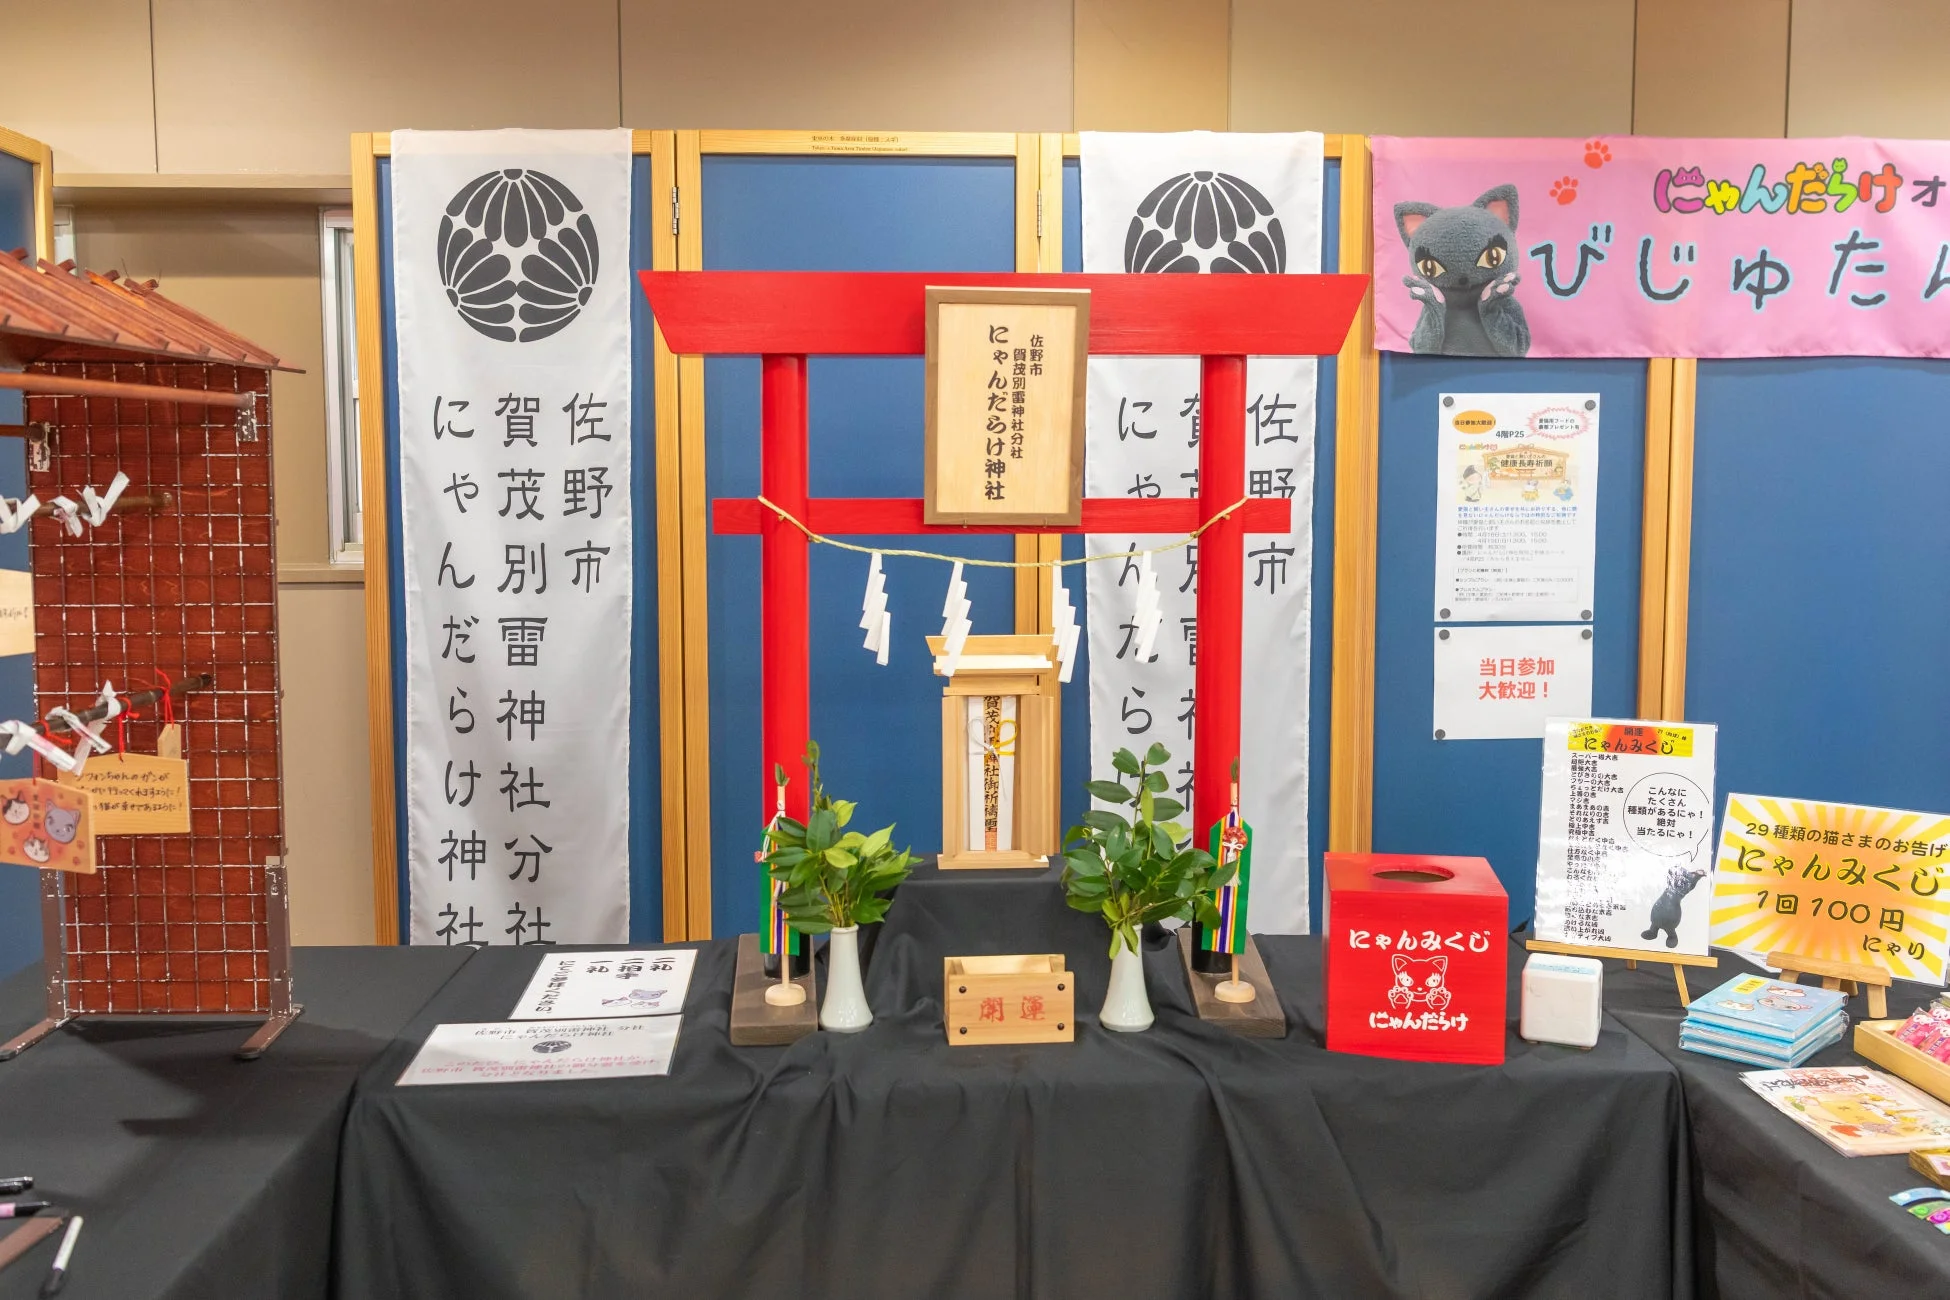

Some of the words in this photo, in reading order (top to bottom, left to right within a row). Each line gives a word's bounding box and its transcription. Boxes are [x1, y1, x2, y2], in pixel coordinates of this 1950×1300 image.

[1653, 159, 1903, 215] にゃんだらけ
[1029, 334, 1044, 376] 佐野市
[984, 324, 1009, 501] にゃんだらけ神社
[1010, 348, 1027, 459] 賀茂別雷神社分社
[1495, 430, 1525, 438] 4階P25
[1500, 459, 1553, 467] 健康長寿祈願
[562, 392, 613, 593] 佐野市
[495, 392, 556, 946] 賀茂別雷神社分社
[1479, 656, 1555, 676] 当日参加
[1478, 681, 1549, 700] 大歓迎！
[1584, 736, 1675, 755] にゃんみくじ
[1648, 786, 1687, 797] こんなに
[1648, 796, 1687, 807] たくさん
[1627, 805, 1703, 819] 種類があるにゃ！
[1656, 817, 1676, 827] 絶対
[1637, 826, 1693, 839] 当たるにゃ！
[1736, 845, 1945, 898] にゃんみくじ
[1349, 928, 1491, 953] にゃんみくじ
[1862, 934, 1926, 961] にゃり
[1368, 1010, 1469, 1032] にゃんだらけ
